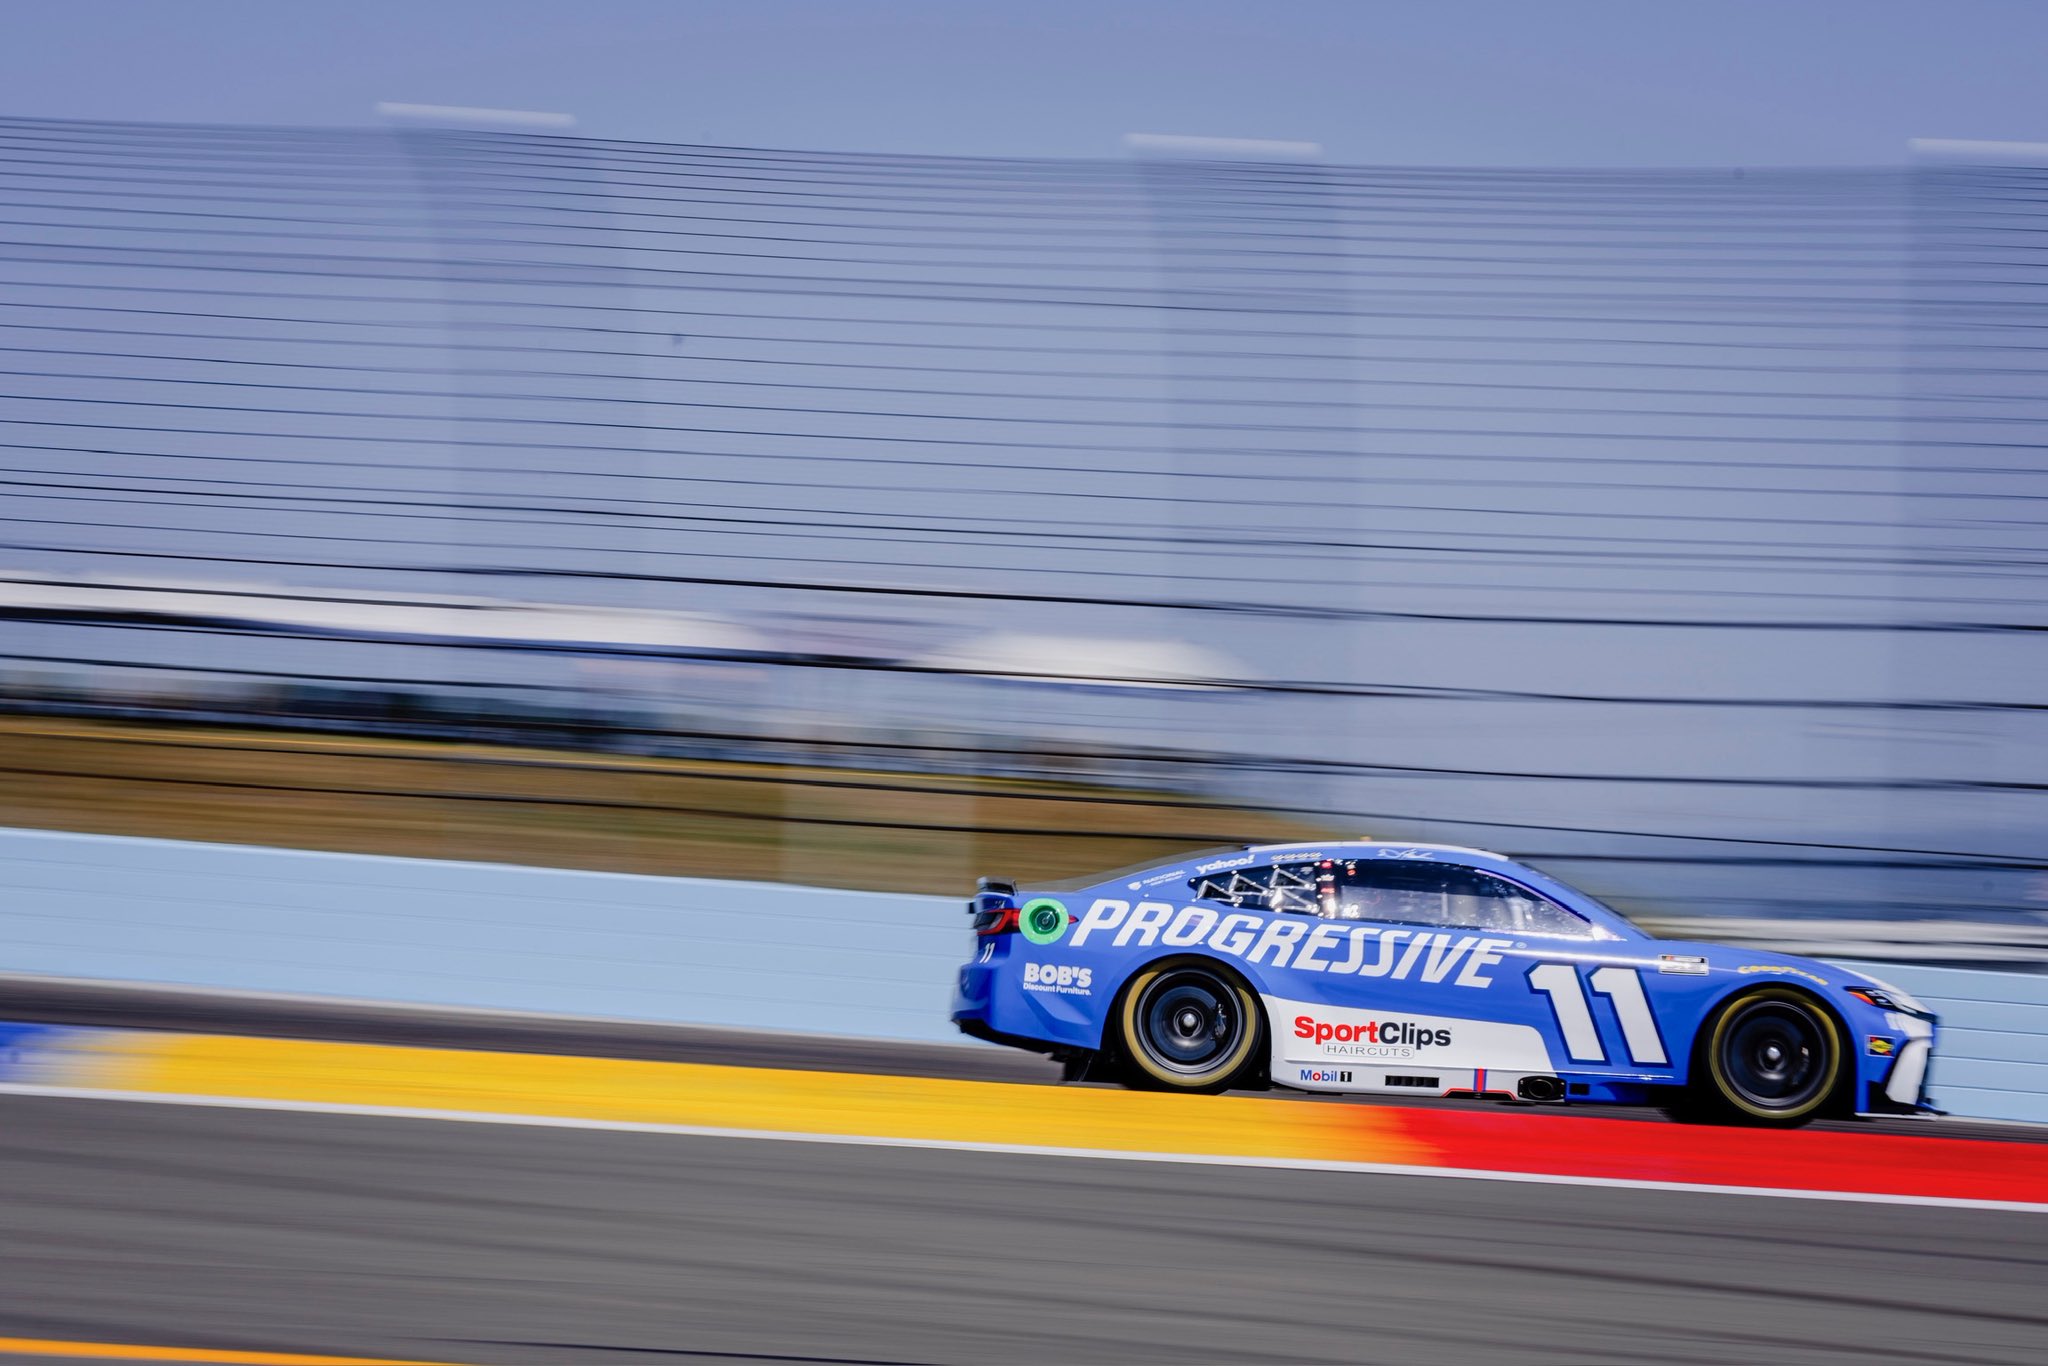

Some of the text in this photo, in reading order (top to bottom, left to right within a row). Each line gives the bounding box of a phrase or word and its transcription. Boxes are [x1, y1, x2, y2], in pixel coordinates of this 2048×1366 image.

[1195, 854, 1255, 875] yahoo!
[979, 942, 996, 964] 11
[1069, 898, 1515, 989] PROGRESSIVE
[1024, 962, 1092, 988] BOB'S
[1023, 982, 1056, 993] Discount
[1526, 962, 1670, 1066] 11
[1294, 1015, 1451, 1050] SportClips
[1326, 1045, 1411, 1058] HAIRCUTS
[1300, 1069, 1352, 1083] Mobil 1
